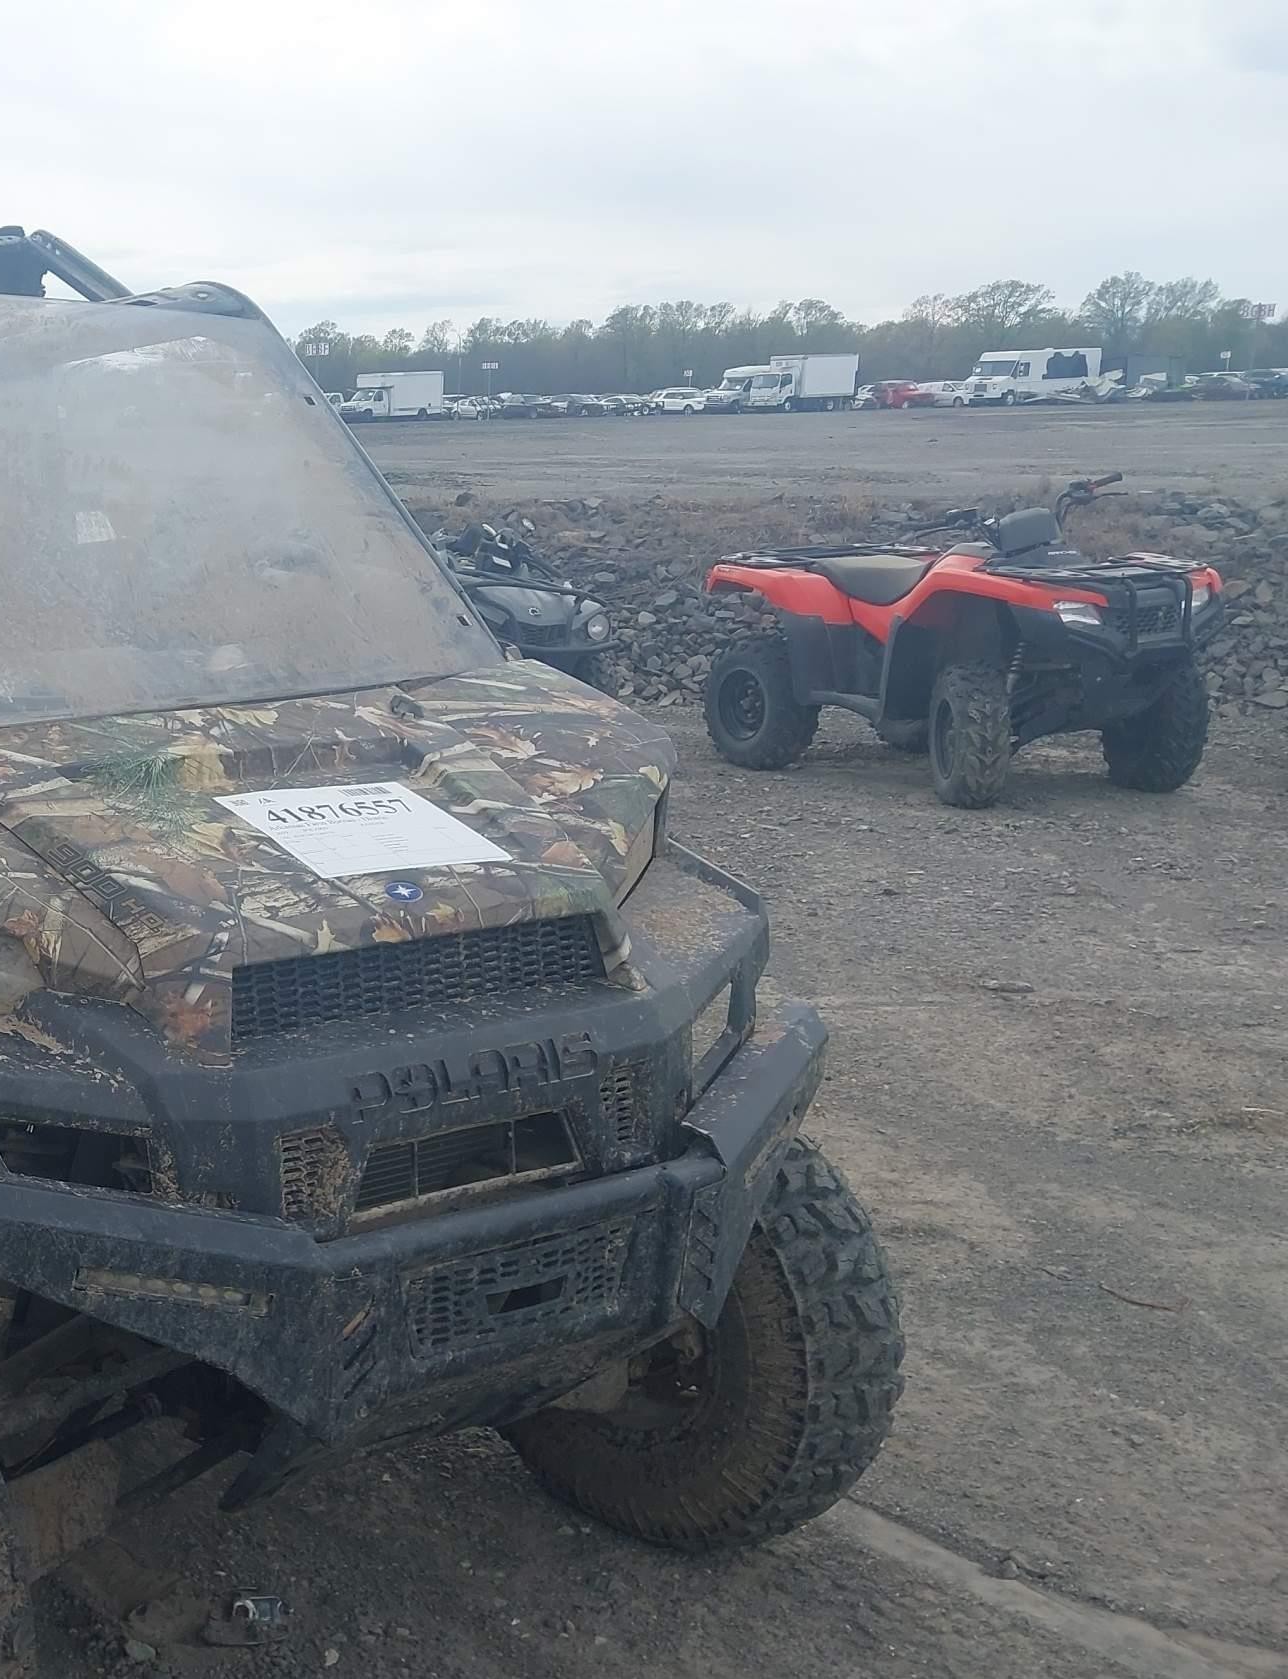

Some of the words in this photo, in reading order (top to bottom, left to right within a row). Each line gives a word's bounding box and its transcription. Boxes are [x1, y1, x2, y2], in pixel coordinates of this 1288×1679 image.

[268, 798, 413, 823] 41876557
[48, 843, 128, 900] 900
[350, 1031, 598, 1124] POLARIS
